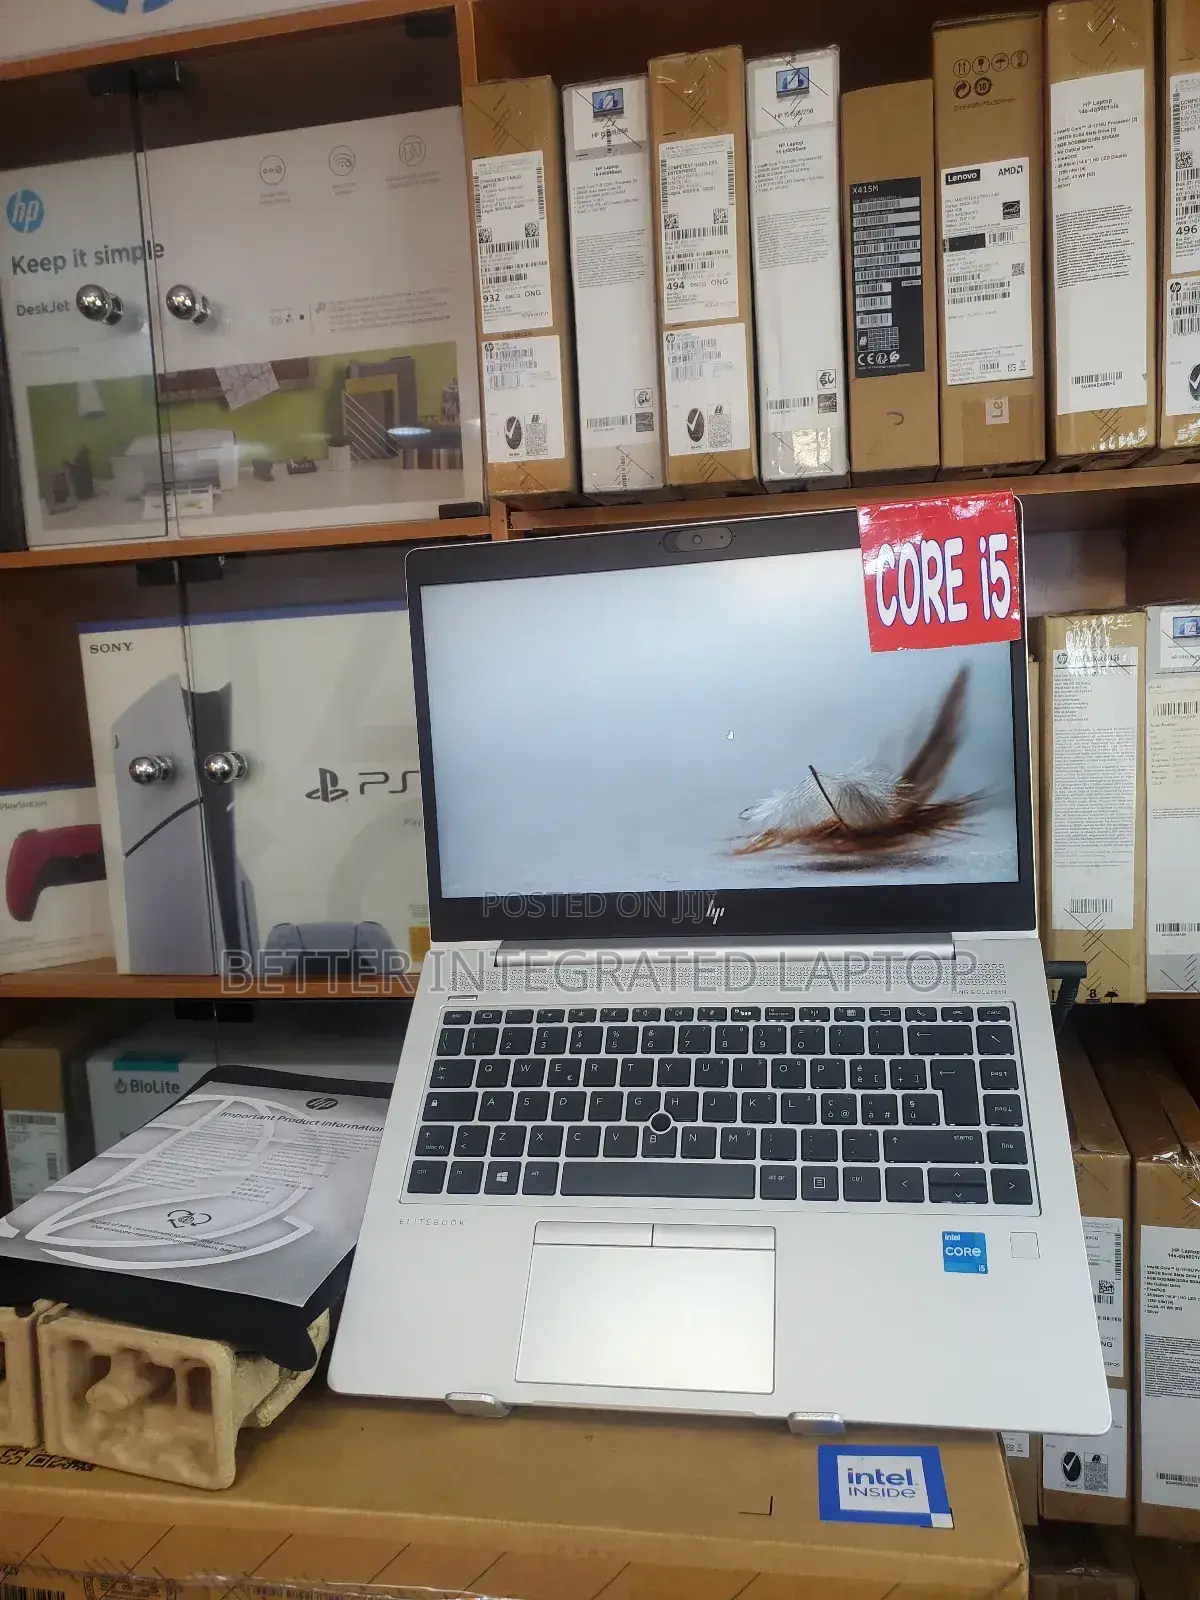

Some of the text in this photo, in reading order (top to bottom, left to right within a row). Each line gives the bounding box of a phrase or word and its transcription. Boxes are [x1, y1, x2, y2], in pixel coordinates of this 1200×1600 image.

[978, 82, 987, 91] 10
[1092, 98, 1113, 106] Laptop
[1107, 118, 1131, 126] Processor
[668, 163, 693, 171] COMPETENT
[668, 168, 697, 176] ENTERPRISES
[947, 166, 1017, 183] Lenovo AMD
[852, 184, 879, 194] X415M
[11, 190, 43, 234] hp
[1175, 224, 1198, 236] 496
[11, 239, 165, 276] Keep it simple
[666, 278, 729, 291] 494 ONG
[482, 289, 542, 303] 932 ONG
[15, 298, 71, 317] DeskJet
[875, 532, 1012, 627] CORE i5
[89, 641, 133, 654] SONY
[1089, 988, 1097, 999] 8
[576, 1030, 583, 1038] $
[505, 1041, 513, 1049] 2
[540, 1041, 547, 1049] 3
[647, 1040, 654, 1048] 6
[721, 1040, 728, 1048] 8
[484, 1064, 493, 1072] Q
[521, 1063, 531, 1072] W
[555, 1063, 562, 1072] E
[591, 1063, 598, 1072] R
[627, 1063, 634, 1072] T
[664, 1063, 672, 1072] Y
[702, 1063, 710, 1072] U
[779, 1064, 788, 1072] O
[817, 1064, 825, 1072] P
[130, 1079, 180, 1094] BioLite
[487, 1097, 795, 1107] A S D F G H J K L
[221, 1111, 275, 1121] Important
[275, 1115, 320, 1126] Product
[498, 1132, 506, 1141] Z
[536, 1132, 544, 1141] X
[573, 1132, 582, 1141] C
[612, 1132, 620, 1141] V
[649, 1134, 657, 1143] B
[688, 1133, 697, 1142] N
[728, 1134, 738, 1143] M
[399, 1218, 466, 1227] ELITEBOOK
[944, 1233, 961, 1241] intel
[978, 1264, 986, 1272] i5
[847, 1467, 913, 1486] intel
